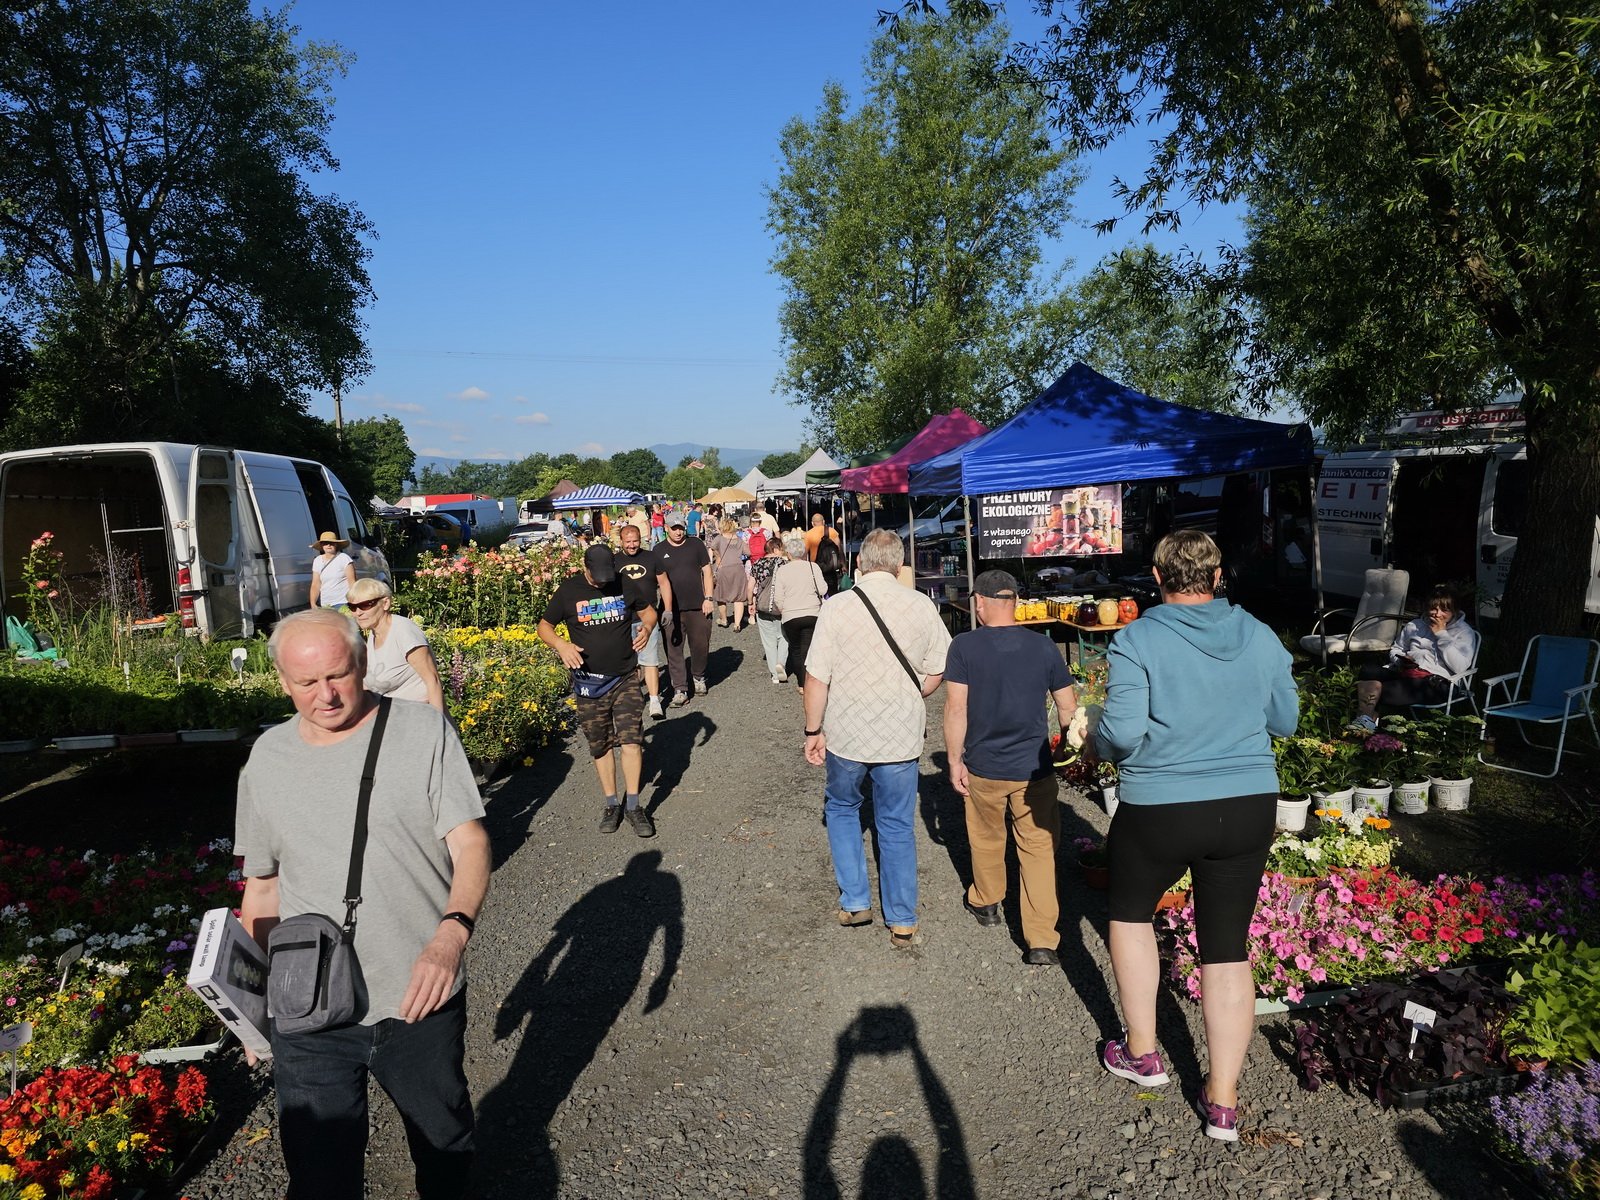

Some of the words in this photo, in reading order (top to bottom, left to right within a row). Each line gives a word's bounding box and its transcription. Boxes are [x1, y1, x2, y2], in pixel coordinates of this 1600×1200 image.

[982, 504, 1052, 518] EKOLOGICZNE
[990, 528, 1031, 537] własnego
[991, 536, 1022, 547] ogrodu
[578, 600, 626, 616] JEANS
[583, 615, 624, 626] CREATIVE
